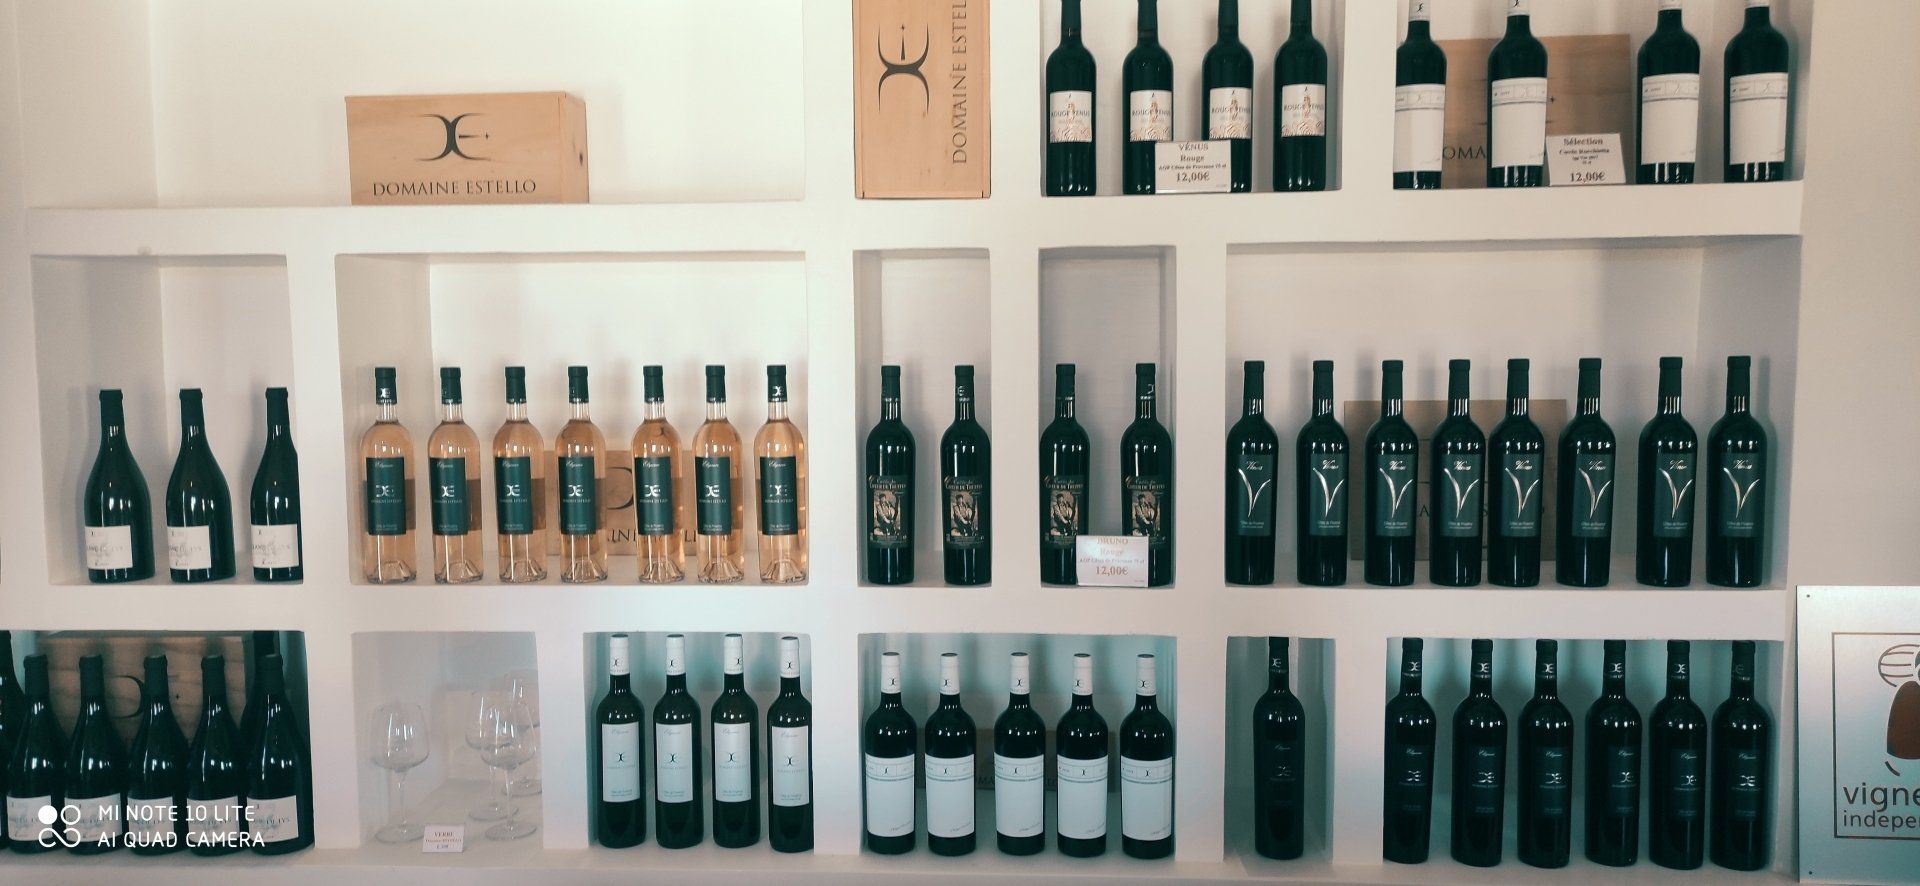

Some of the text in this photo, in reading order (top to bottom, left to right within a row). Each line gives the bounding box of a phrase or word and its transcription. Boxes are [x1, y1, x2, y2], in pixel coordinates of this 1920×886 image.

[952, 63, 967, 164] DOMAINE
[1563, 137, 1603, 146] Sélection
[1180, 154, 1205, 163] Rouge
[1177, 171, 1210, 183] 12,00€
[1570, 171, 1606, 183] 12,00€
[373, 178, 537, 197] DOMAINE ESTELLO
[1096, 566, 1129, 576] 12,00€
[1843, 810, 1920, 832] indepe
